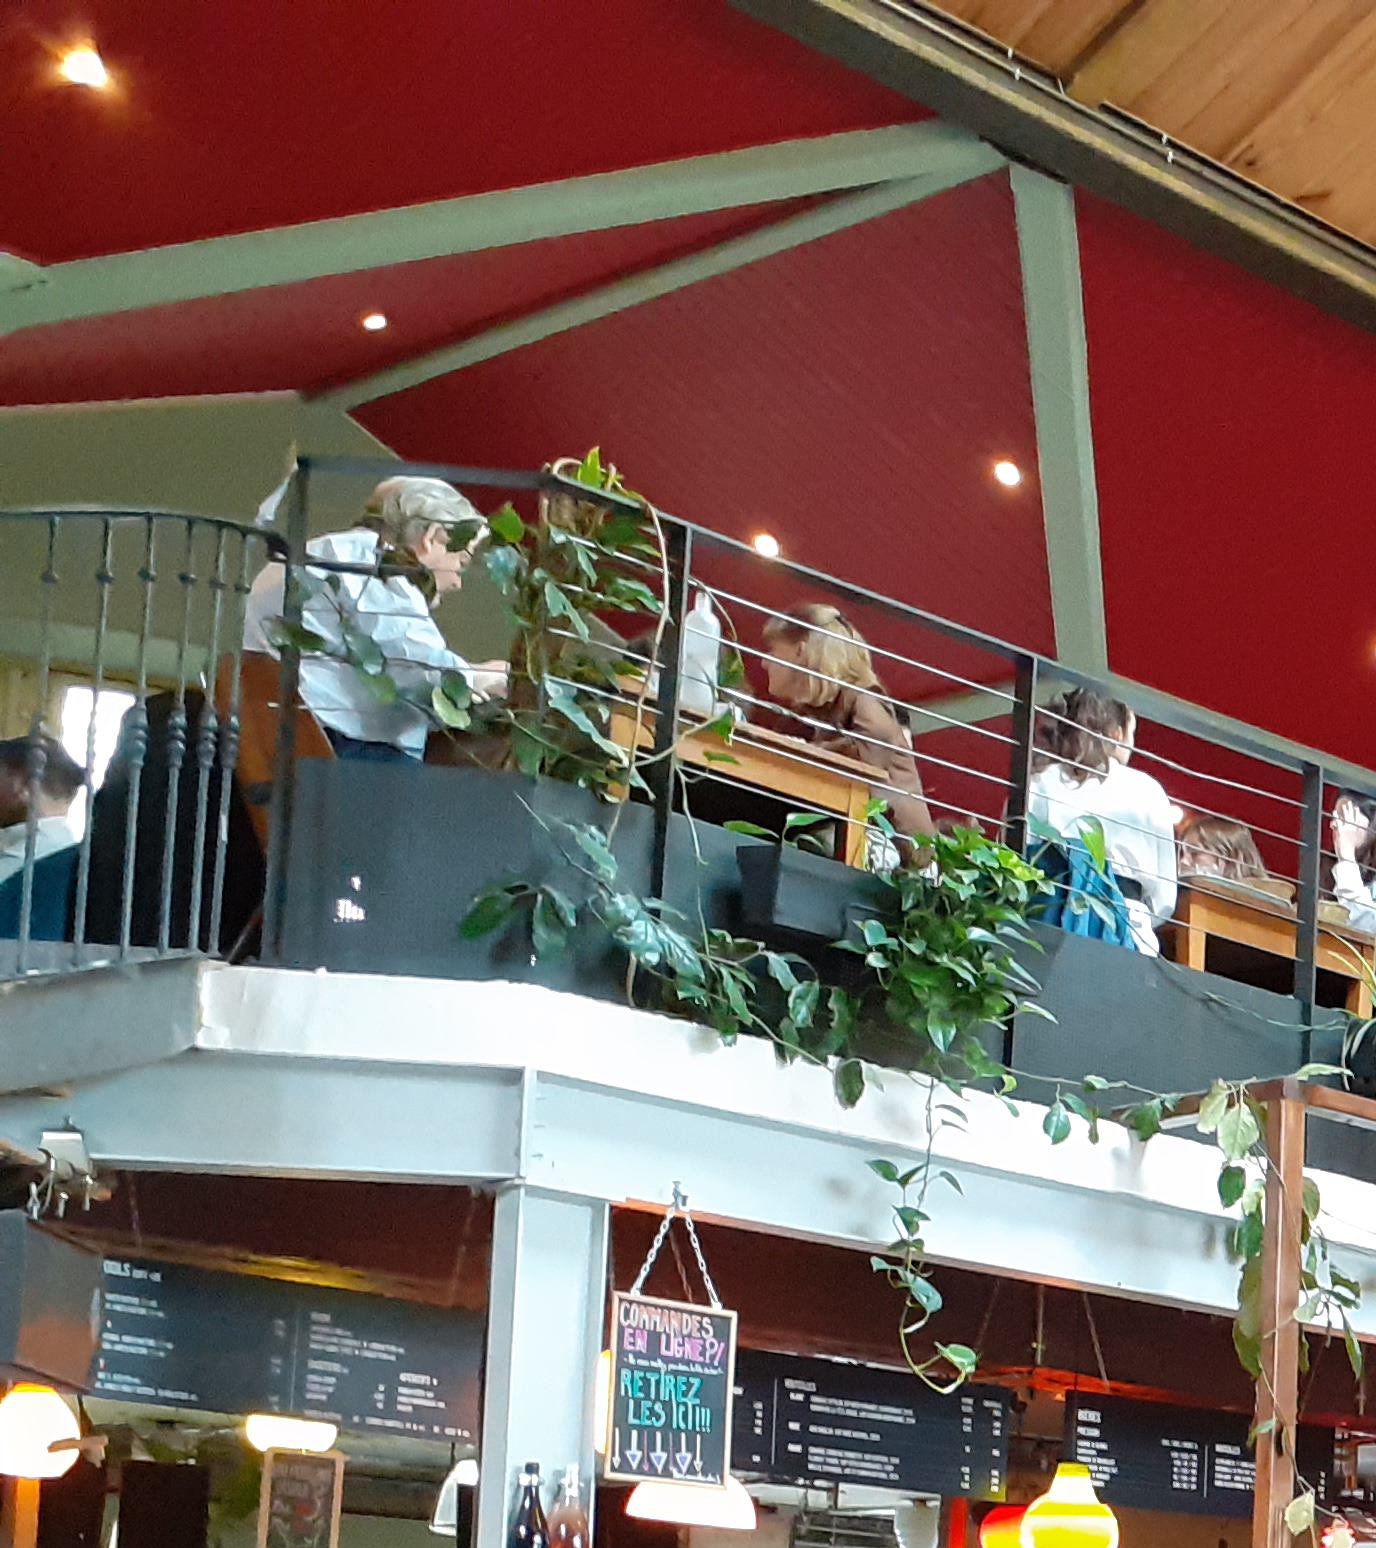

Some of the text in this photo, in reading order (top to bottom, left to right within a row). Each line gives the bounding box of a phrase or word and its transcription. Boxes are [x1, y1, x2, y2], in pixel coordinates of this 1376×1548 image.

[619, 1302, 714, 1338] COMMANDES
[623, 1328, 648, 1353] EN
[620, 1368, 704, 1404] RETIREZ
[627, 1399, 666, 1428] LES
